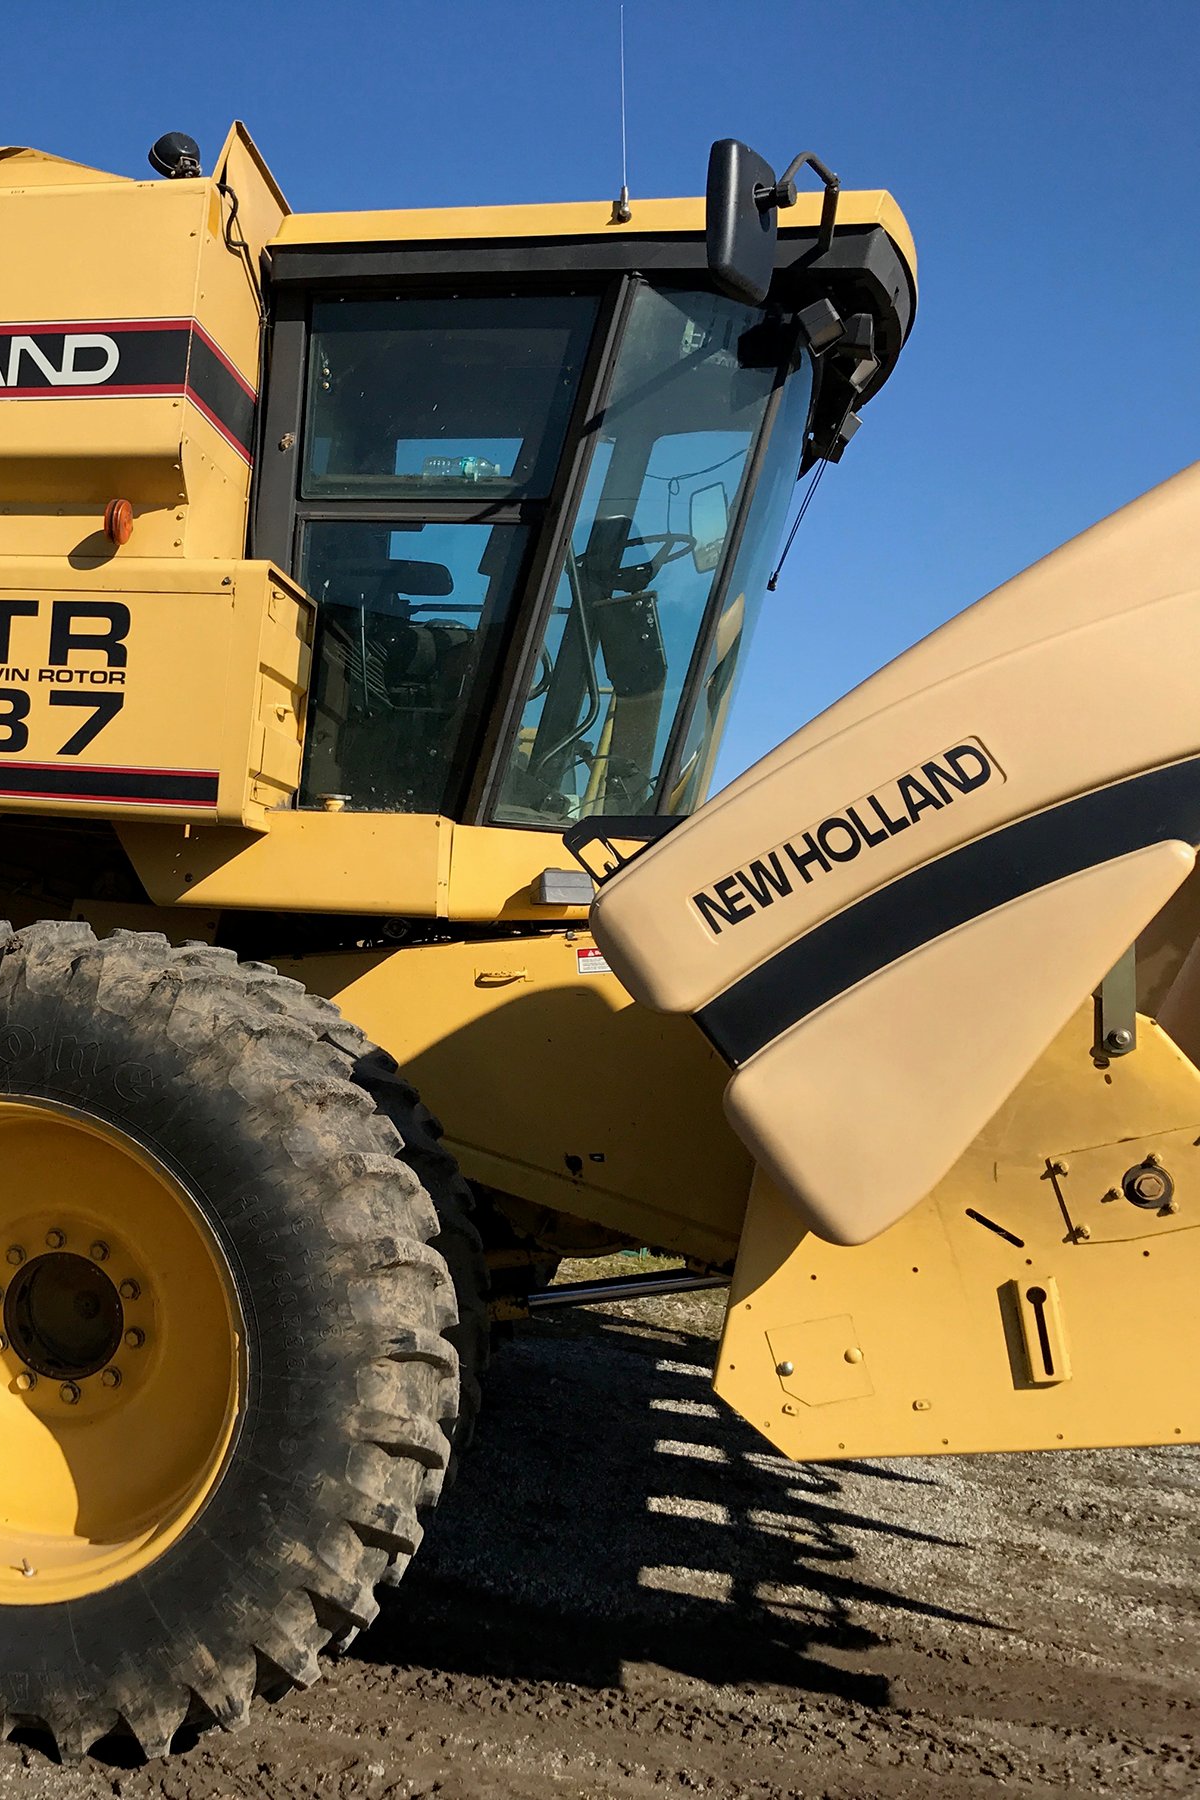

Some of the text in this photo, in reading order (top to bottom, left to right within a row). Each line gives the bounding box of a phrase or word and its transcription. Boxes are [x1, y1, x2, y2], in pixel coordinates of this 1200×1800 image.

[38, 669, 126, 685] ROTOR
[692, 745, 991, 935] NEW HOLLAND
